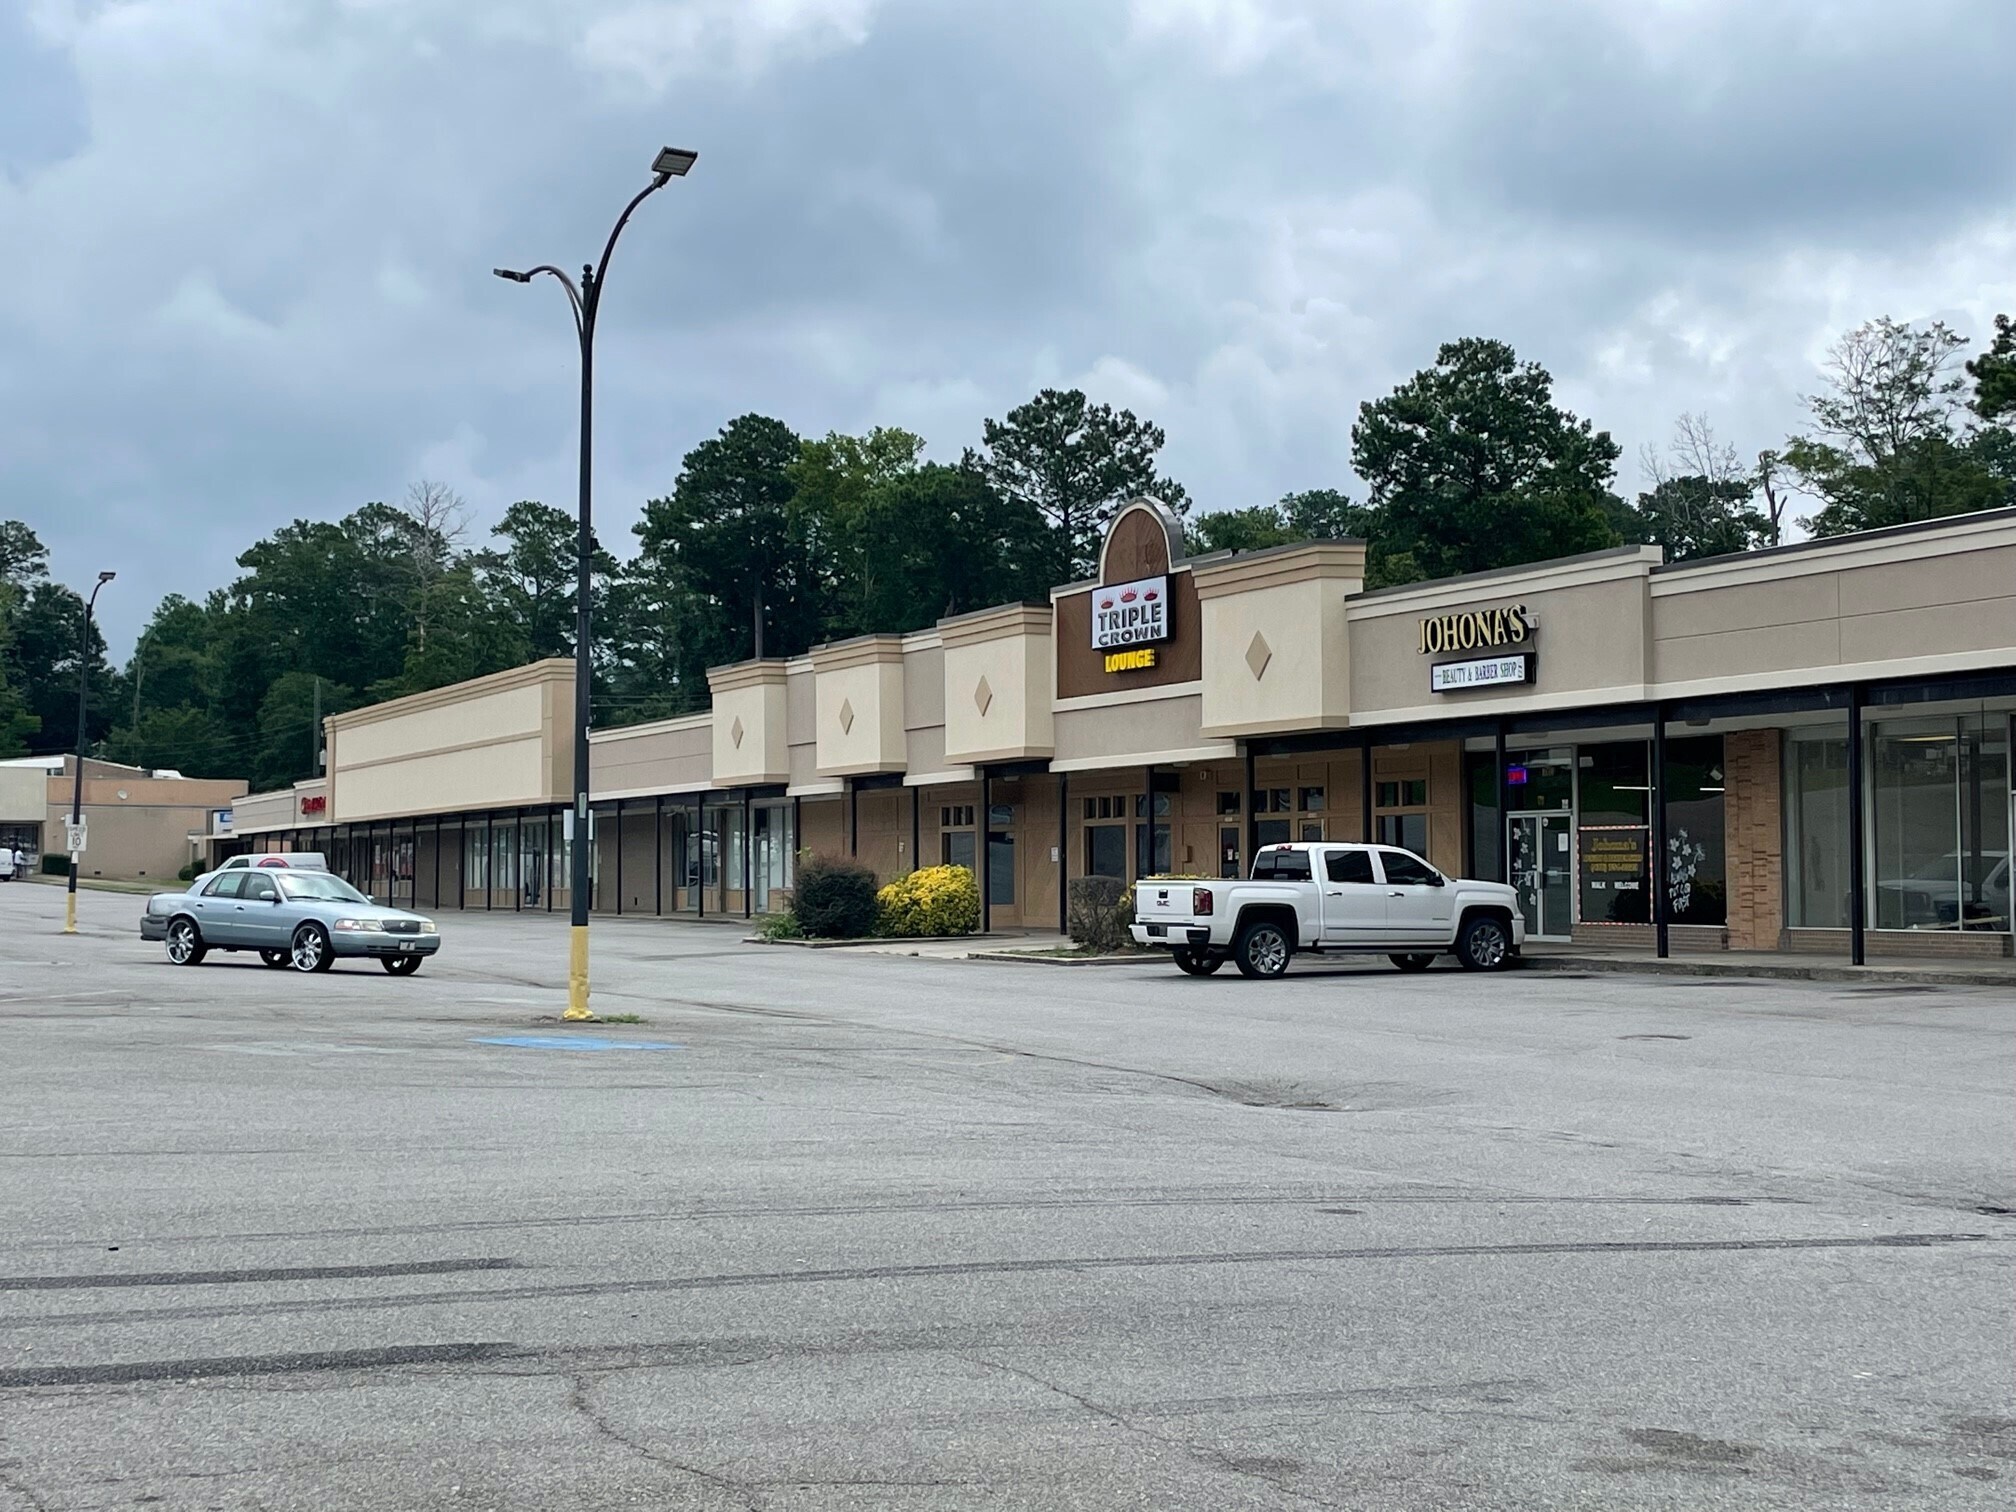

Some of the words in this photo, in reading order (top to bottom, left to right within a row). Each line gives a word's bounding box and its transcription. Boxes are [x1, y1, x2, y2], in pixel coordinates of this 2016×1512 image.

[1098, 602, 1162, 632] TRIPLE
[1098, 625, 1162, 646] CROWN
[1418, 605, 1527, 654] JOHONA'S
[1105, 649, 1154, 672] LOUNGE
[1442, 667, 1466, 684] BEAUTY
[1468, 666, 1472, 682] &
[1475, 663, 1498, 681] BARBER
[1500, 661, 1517, 678] SHOP
[72, 837, 81, 846] 10
